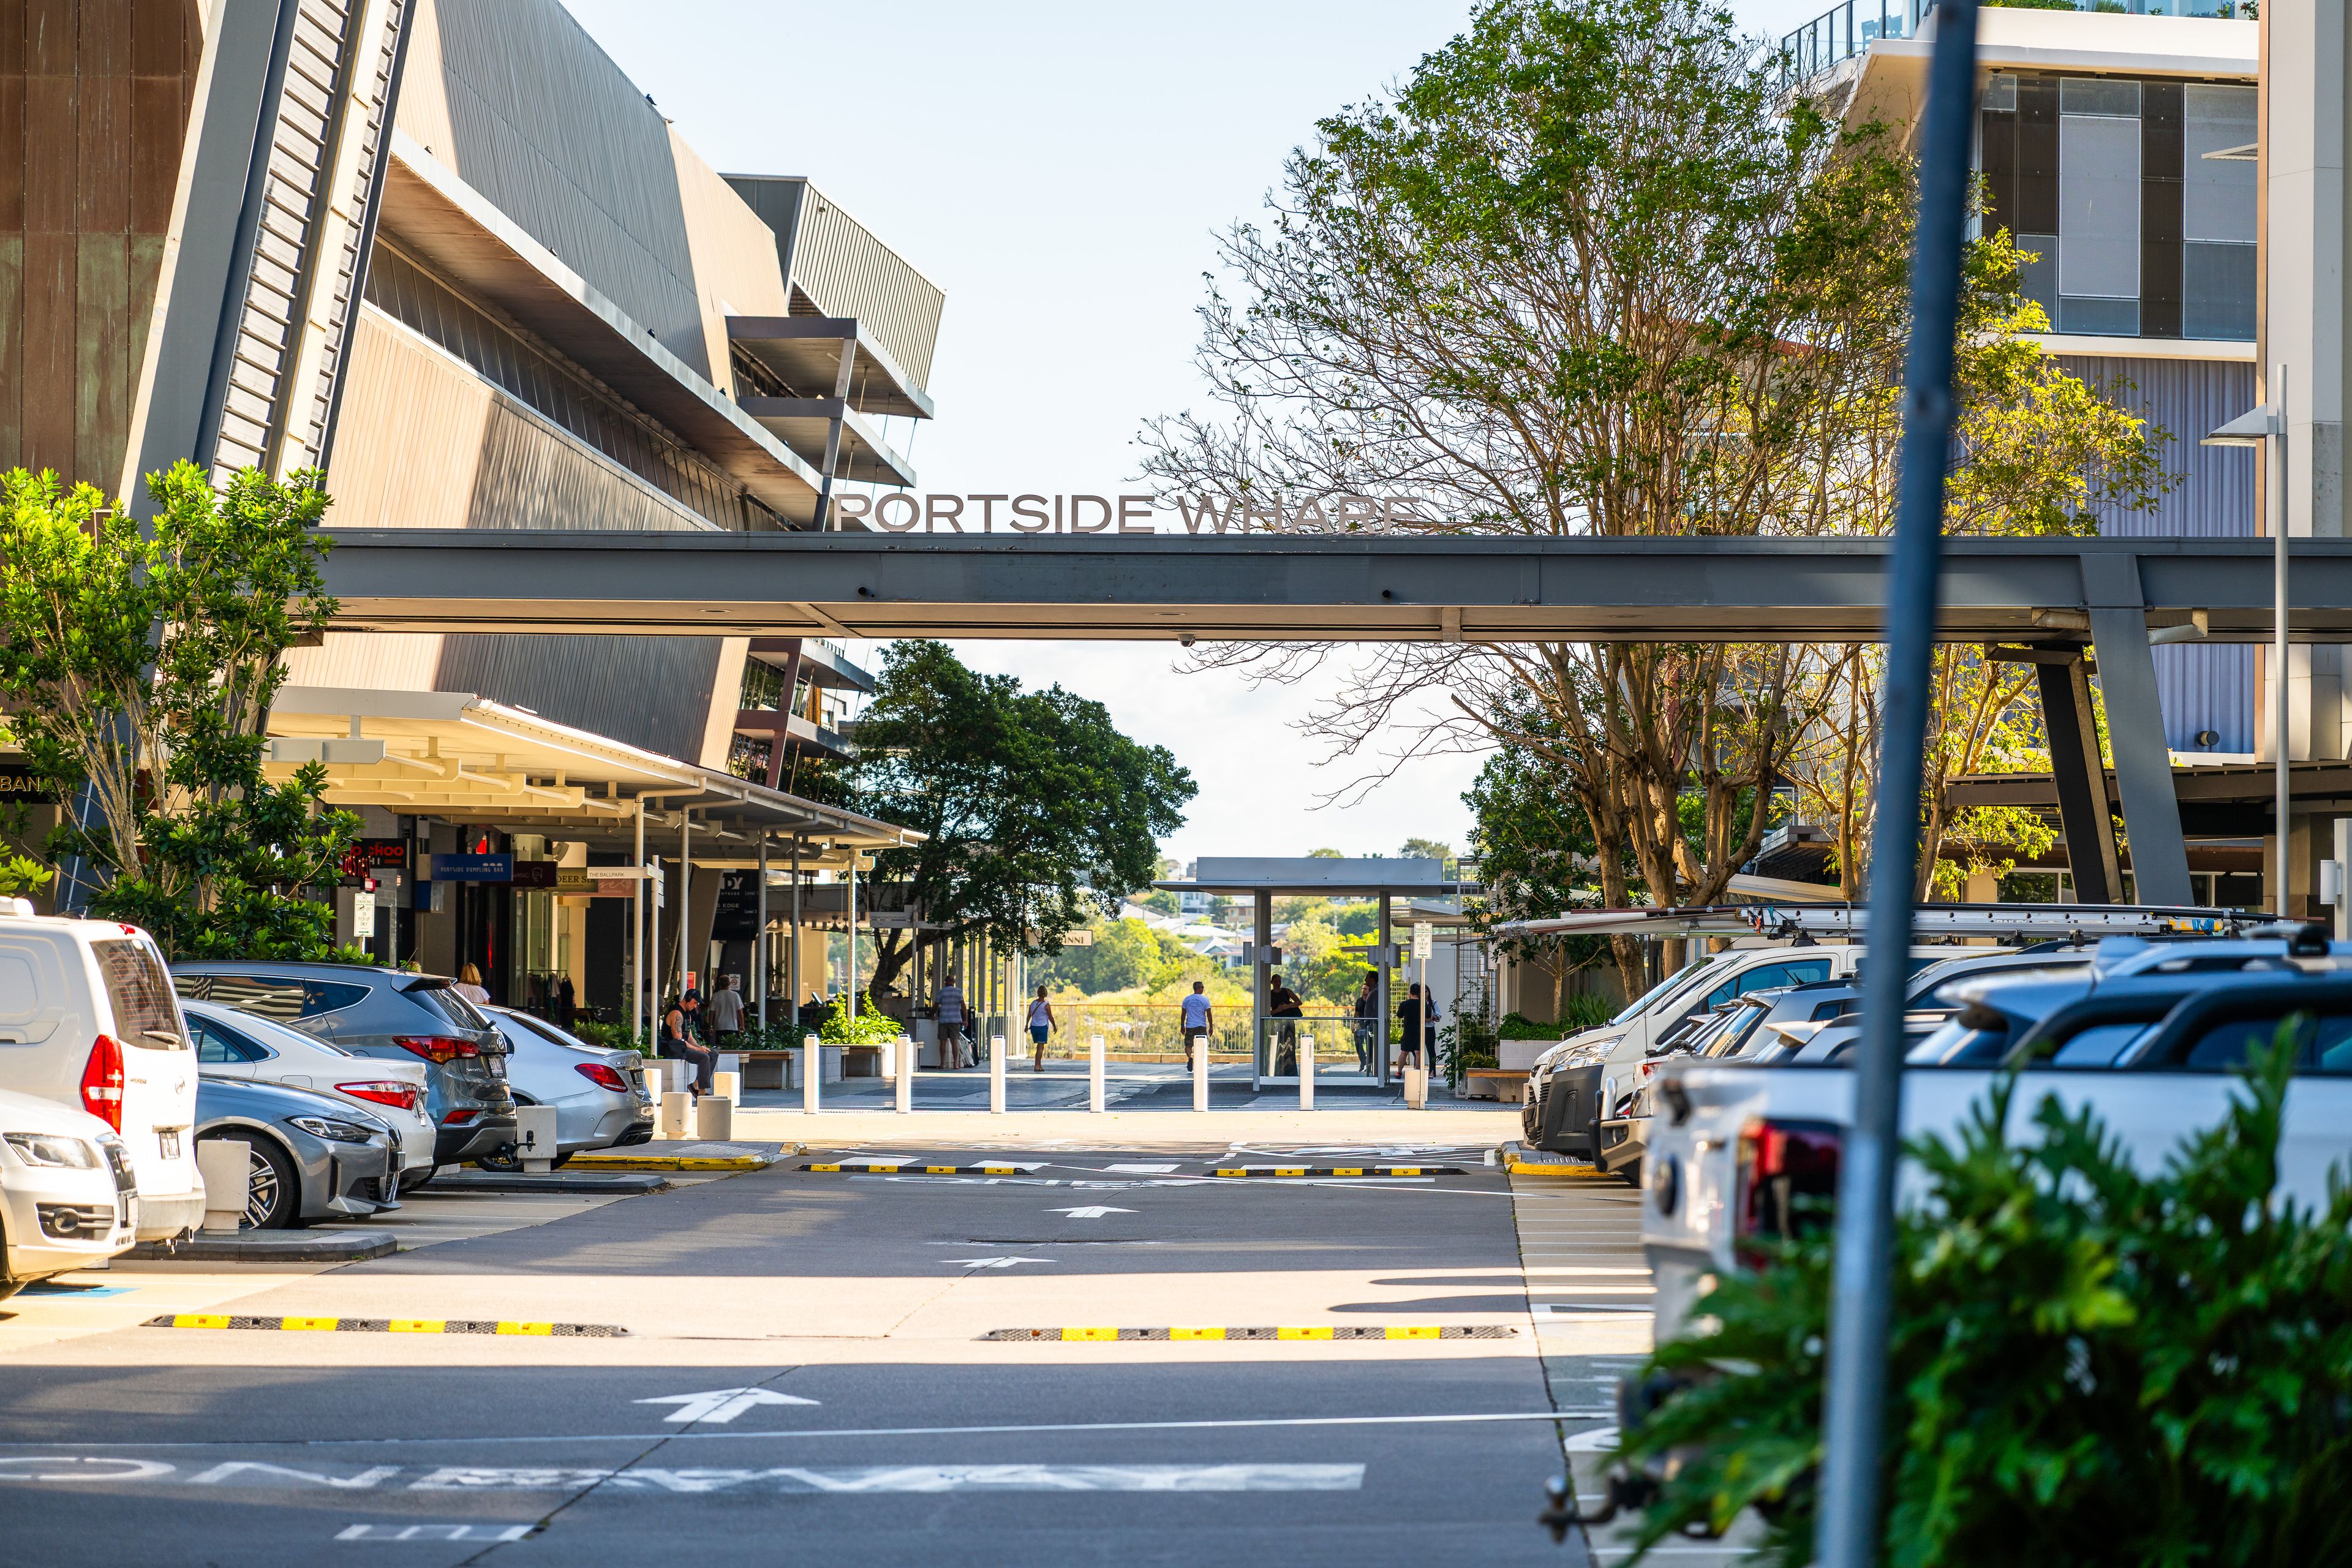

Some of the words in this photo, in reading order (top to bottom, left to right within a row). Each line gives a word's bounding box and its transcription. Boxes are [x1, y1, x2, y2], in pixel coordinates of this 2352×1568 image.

[834, 492, 1156, 533] PORTSIDE
[1176, 495, 1420, 535] WHARF
[0, 775, 45, 792] BAN
